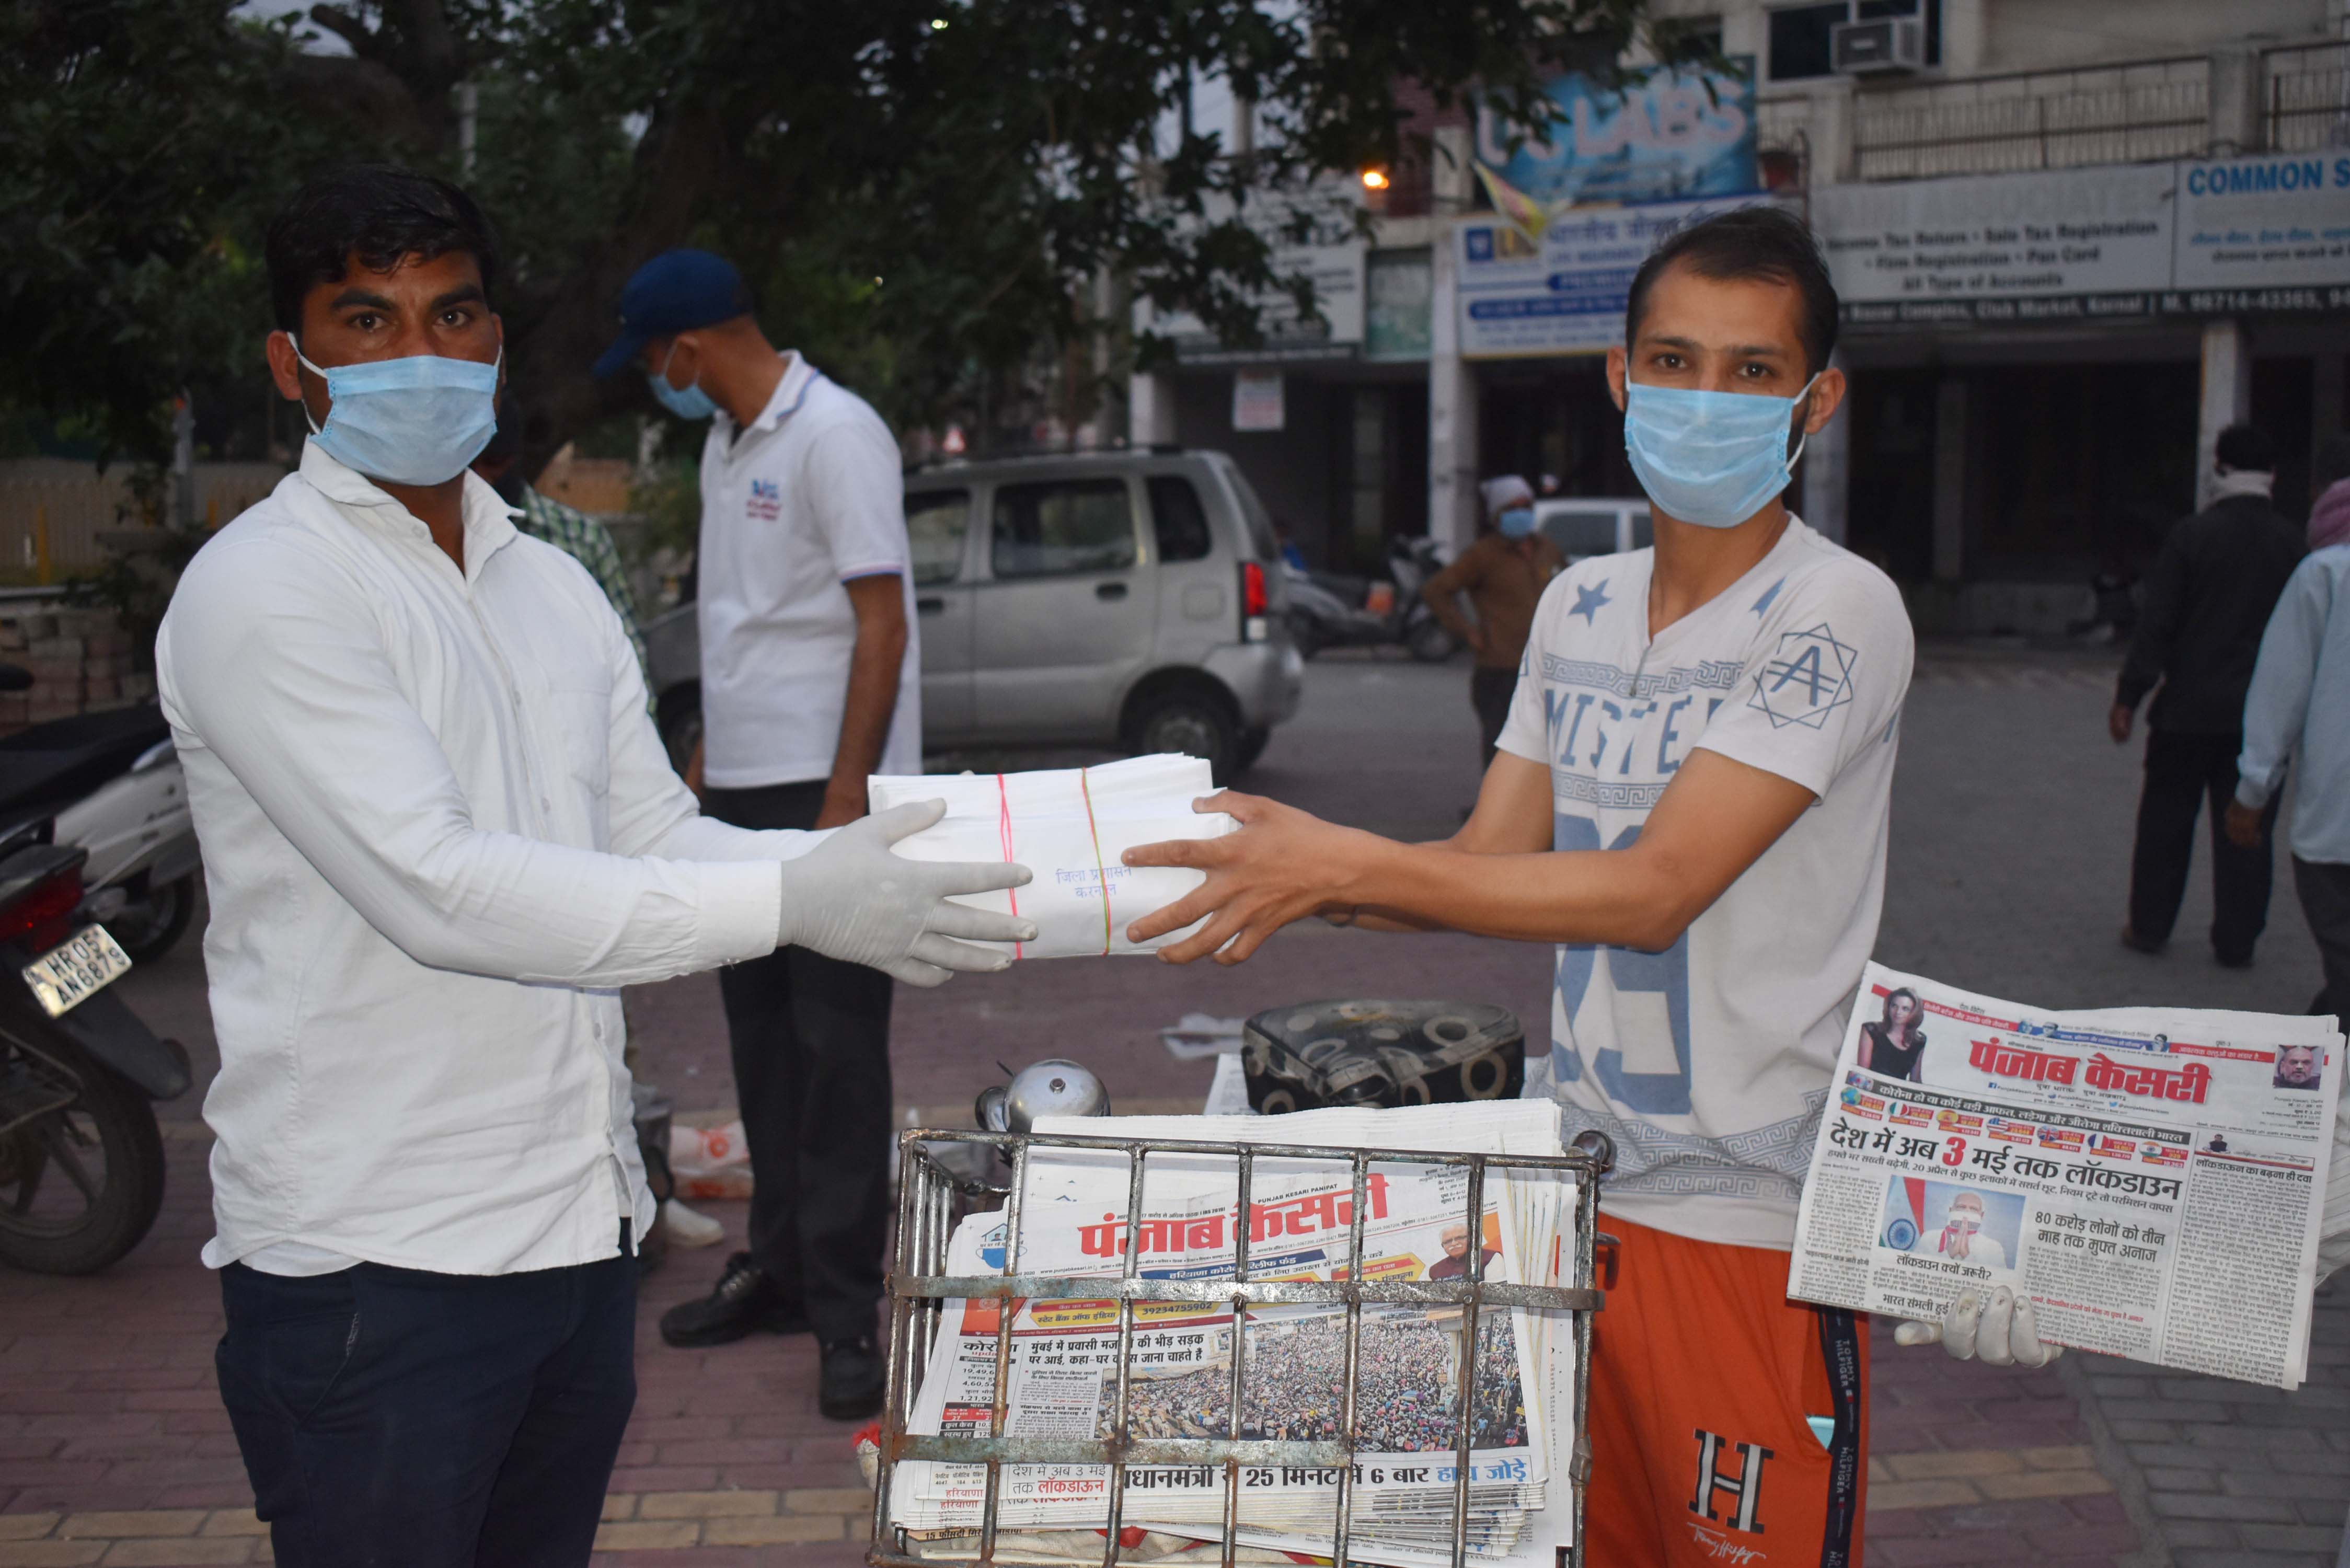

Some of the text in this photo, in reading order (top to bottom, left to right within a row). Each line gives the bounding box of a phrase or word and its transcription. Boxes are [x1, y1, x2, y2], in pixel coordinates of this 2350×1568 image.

[1575, 67, 1747, 156] LABS
[2187, 158, 2324, 195] COMMON
[1885, 234, 1909, 248] Tax
[1916, 230, 1967, 247] Return
[2024, 225, 2052, 242] Tax
[2057, 220, 2158, 239] Registration
[1914, 252, 2010, 269] Registration
[2062, 246, 2100, 262] Card
[1927, 274, 1962, 292] Type
[1989, 272, 2063, 287] Accounts
[1055, 868, 1086, 885] जिला
[1969, 1036, 2213, 1105] पंजाब केसरी
[1879, 1083, 1913, 1102] कोरोना
[1914, 1089, 1925, 1103] हो
[1926, 1093, 1938, 1104] या
[1940, 1095, 1962, 1108] कोई
[1963, 1099, 1982, 1112] बड़ी
[1984, 1105, 2016, 1118] आफत,
[2018, 1109, 2046, 1123] लड़ेगा
[2047, 1113, 2066, 1126] और
[2068, 1116, 2100, 1131] जीतेगा
[2101, 1122, 2155, 1139] शक्तिशाली
[2157, 1131, 2184, 1143] भारत
[1830, 1116, 1869, 1149] देश
[1872, 1127, 1896, 1154] में
[1895, 1136, 1939, 1161] अब
[1942, 1136, 1967, 1167] 3
[1972, 1145, 2012, 1174] मई
[2013, 1155, 2061, 1180] तक
[2065, 1159, 2183, 1200] लॉकडाउन
[1827, 1149, 1848, 1161] हफ्ते
[1848, 1153, 1859, 1162] भर
[1912, 1163, 1924, 1172] 20
[1926, 1163, 1948, 1176] अप्रैल
[1950, 1167, 1958, 1177] से
[1959, 1170, 1977, 1181] कुछ
[1978, 1172, 2007, 1186] इलाकों
[2018, 1180, 2041, 1193] सशर्त
[2059, 1185, 2083, 1198] नियम
[2084, 1190, 2099, 1203] टूटे
[2099, 1193, 2111, 1203] तो
[2111, 1195, 2147, 1208] परमिशन
[2148, 1202, 2173, 1214] वापस
[2245, 1165, 2312, 1184] का ही दवा
[1258, 1183, 1338, 1204] PUNJAB KESARI PANIPAT
[1077, 1173, 1390, 1258] पंजाब केसरी
[2034, 1211, 2165, 1247] 80 करोड़ लोगों को तीन
[2037, 1228, 2158, 1263] माह तक मुफ्त अनाज
[1040, 1265, 1093, 1274] www.punjabkesari.in
[1169, 1256, 1297, 1281] हरियाणा फंड
[1262, 1269, 1272, 1277] के
[1274, 1267, 1290, 1276] लिए
[1292, 1263, 1320, 1272] उदारता
[1369, 1249, 1384, 1259] करें
[1896, 1253, 1992, 1281] लॉकडाउन क्यों जरूरी?
[1381, 1271, 1414, 1282] पंचकूला
[1037, 1310, 1116, 1323] स्टेट बैंक ऑफ इंडिया
[1142, 1301, 1213, 1316] 39234755902
[1882, 1293, 1950, 1316] भारत संभली हुई
[1031, 1333, 1205, 1354] मुंबई में प्रवासी की भीड़ सड़क
[1029, 1354, 1042, 1365] पर
[1043, 1350, 1066, 1366] आई,
[1141, 1352, 1165, 1363] जाना
[1167, 1348, 1192, 1362] चाहते
[1835, 1339, 1848, 1388] HILFIGER
[1844, 1339, 1855, 1382] TOMMY
[1012, 1463, 1107, 1478] देश में अब 3 मई
[1246, 1458, 1527, 1488] 25 मिनट 6 बार जोड़े
[1688, 1427, 1774, 1534] H
[1836, 1446, 1849, 1494] HILFIGER
[1845, 1447, 1854, 1490] TOMMY
[945, 1487, 984, 1498] हरियाणा
[1012, 1482, 1033, 1494] तक
[939, 1498, 980, 1509] हरियाणा
[925, 1527, 965, 1541] 15 फीसदी
